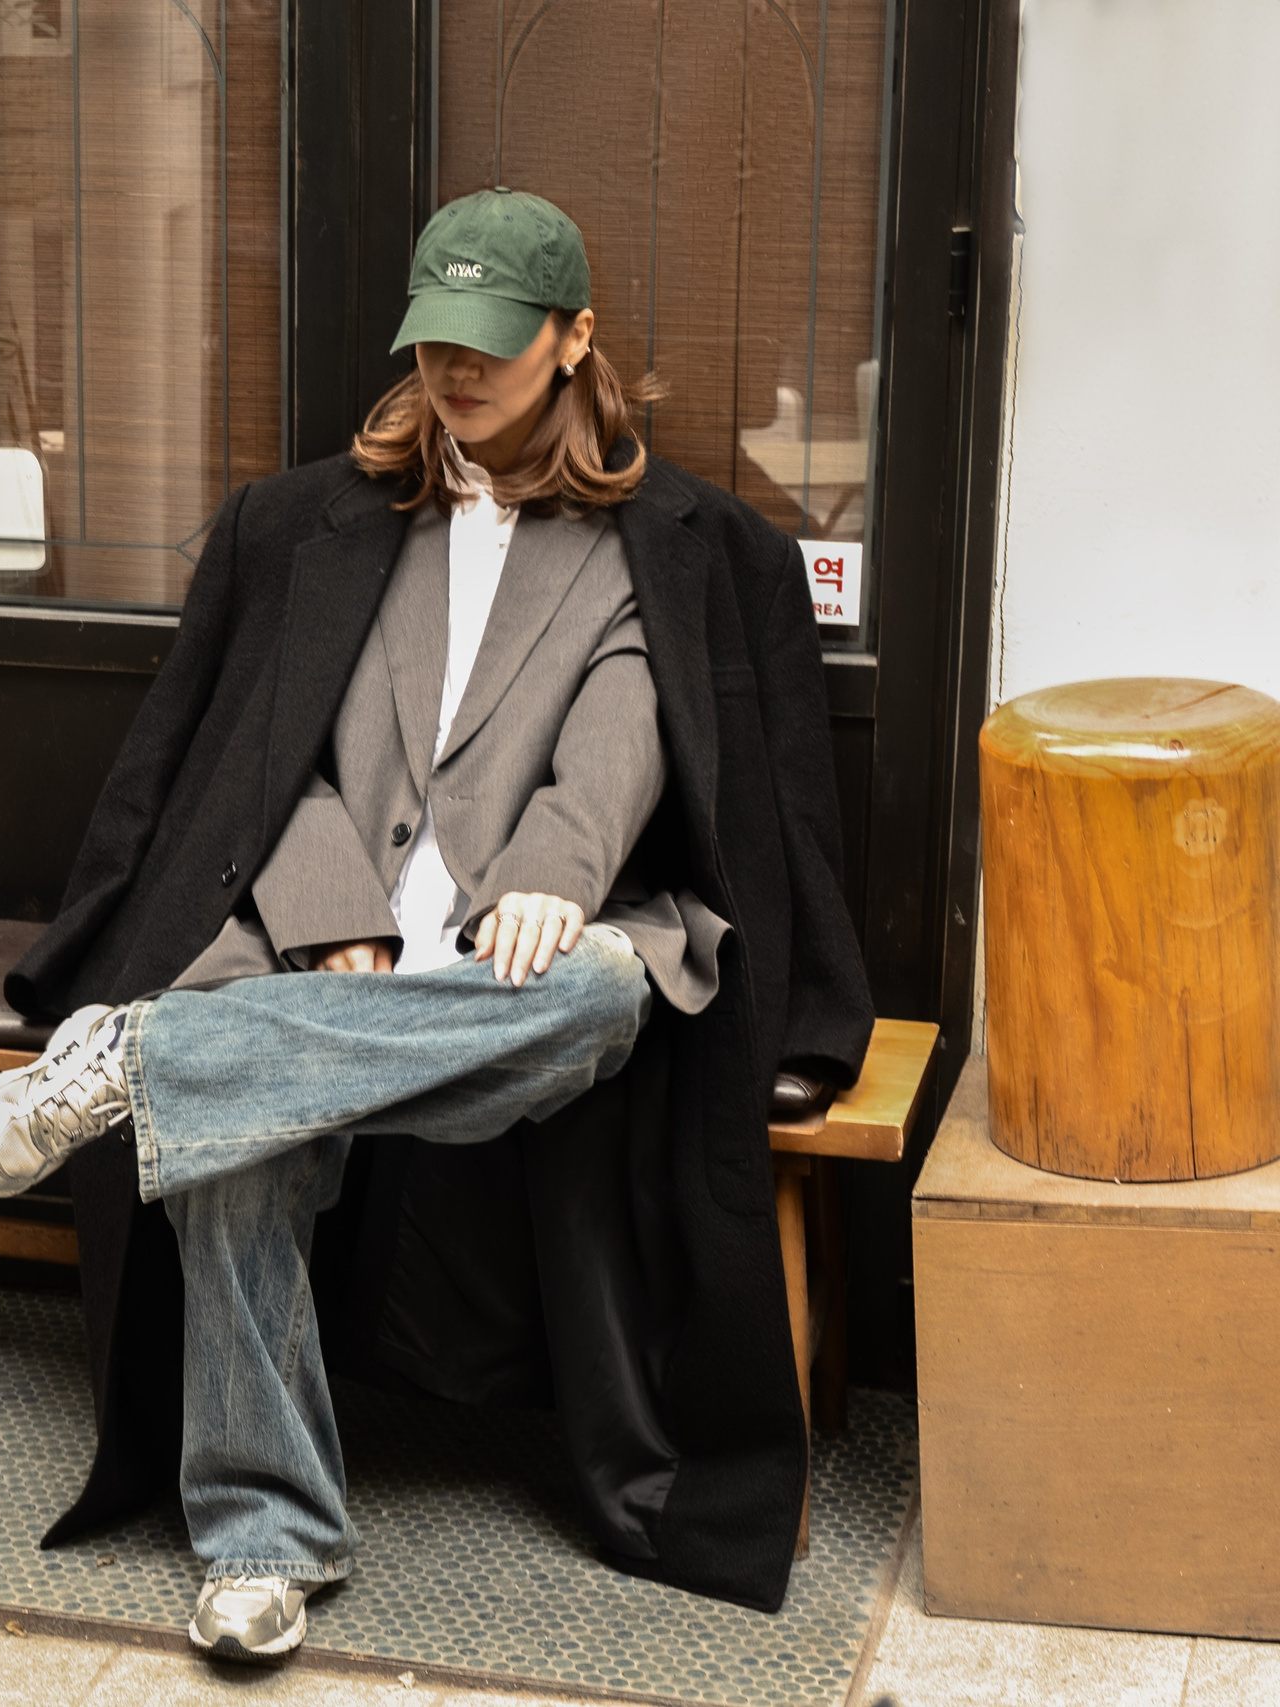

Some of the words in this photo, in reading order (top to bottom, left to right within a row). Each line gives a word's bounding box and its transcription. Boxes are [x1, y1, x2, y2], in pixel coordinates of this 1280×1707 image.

[446, 262, 482, 278] NYAC
[813, 557, 844, 593] 역
[813, 602, 844, 616] REA
